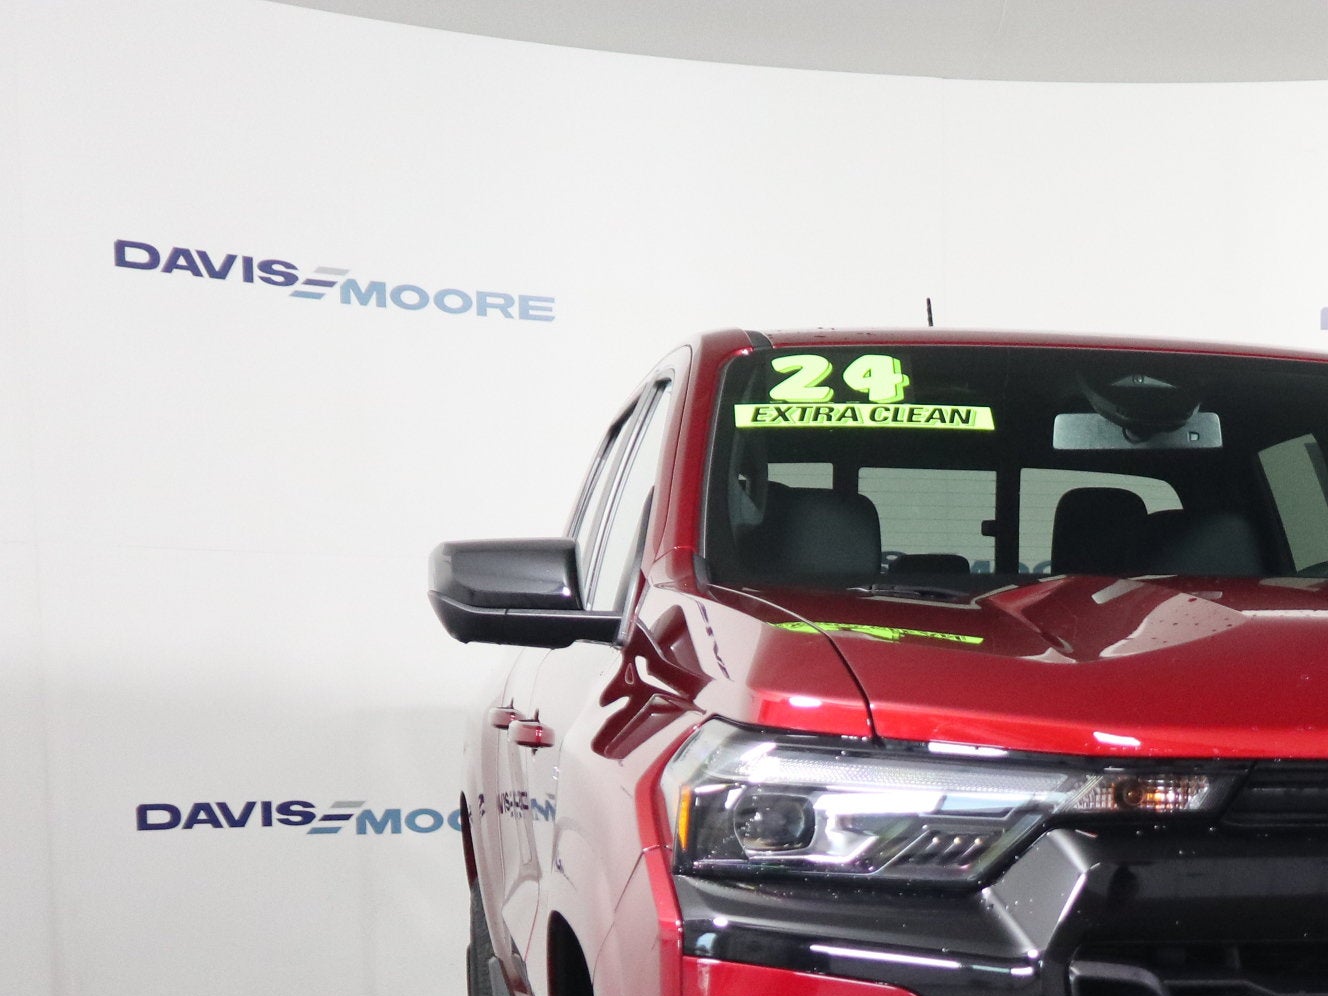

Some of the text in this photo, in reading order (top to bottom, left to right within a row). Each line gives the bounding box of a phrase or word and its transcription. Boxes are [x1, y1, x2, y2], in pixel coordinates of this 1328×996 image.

[113, 238, 556, 322] DAVIS MOORE
[769, 354, 909, 403] 24
[750, 405, 974, 426] EXTRA CLEAN
[135, 799, 318, 832] DAVIS
